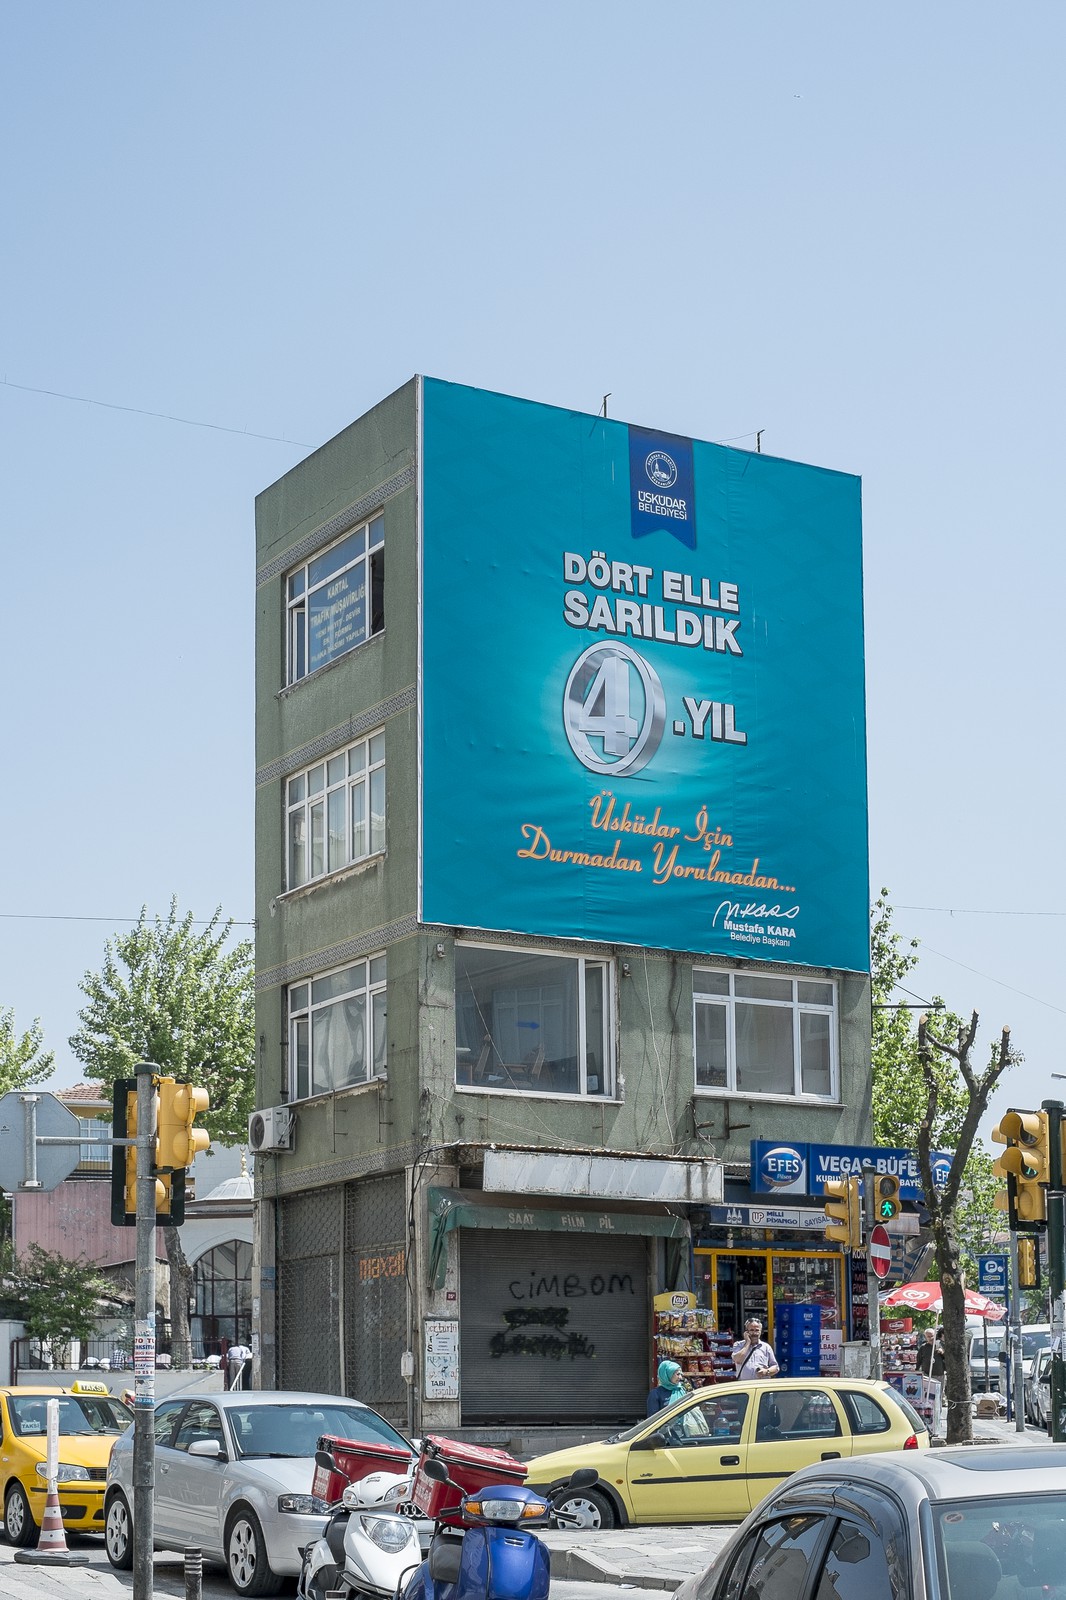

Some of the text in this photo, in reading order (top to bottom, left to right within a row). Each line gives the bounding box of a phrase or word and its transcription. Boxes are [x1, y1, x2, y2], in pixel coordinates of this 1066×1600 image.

[638, 490, 686, 511] ÜSKÜDAR
[638, 502, 687, 520] BELEDİYESİ
[327, 578, 348, 599] KARTAL
[563, 550, 740, 613] DÖRT ELLE
[563, 589, 744, 657] SARILDIK
[589, 790, 734, 851] Üsküdar İçin
[517, 823, 796, 892] Durmadan Yorulmadan...
[723, 920, 797, 938] Mustafa KARA
[730, 931, 790, 947] Belediye Başkanı
[767, 1158, 800, 1173] EFES
[508, 1212, 615, 1229] SAAT FİLM PİL
[766, 1217, 798, 1225] PİYANGO
[804, 1216, 830, 1227] SAYISAL
[987, 1263, 996, 1271] P
